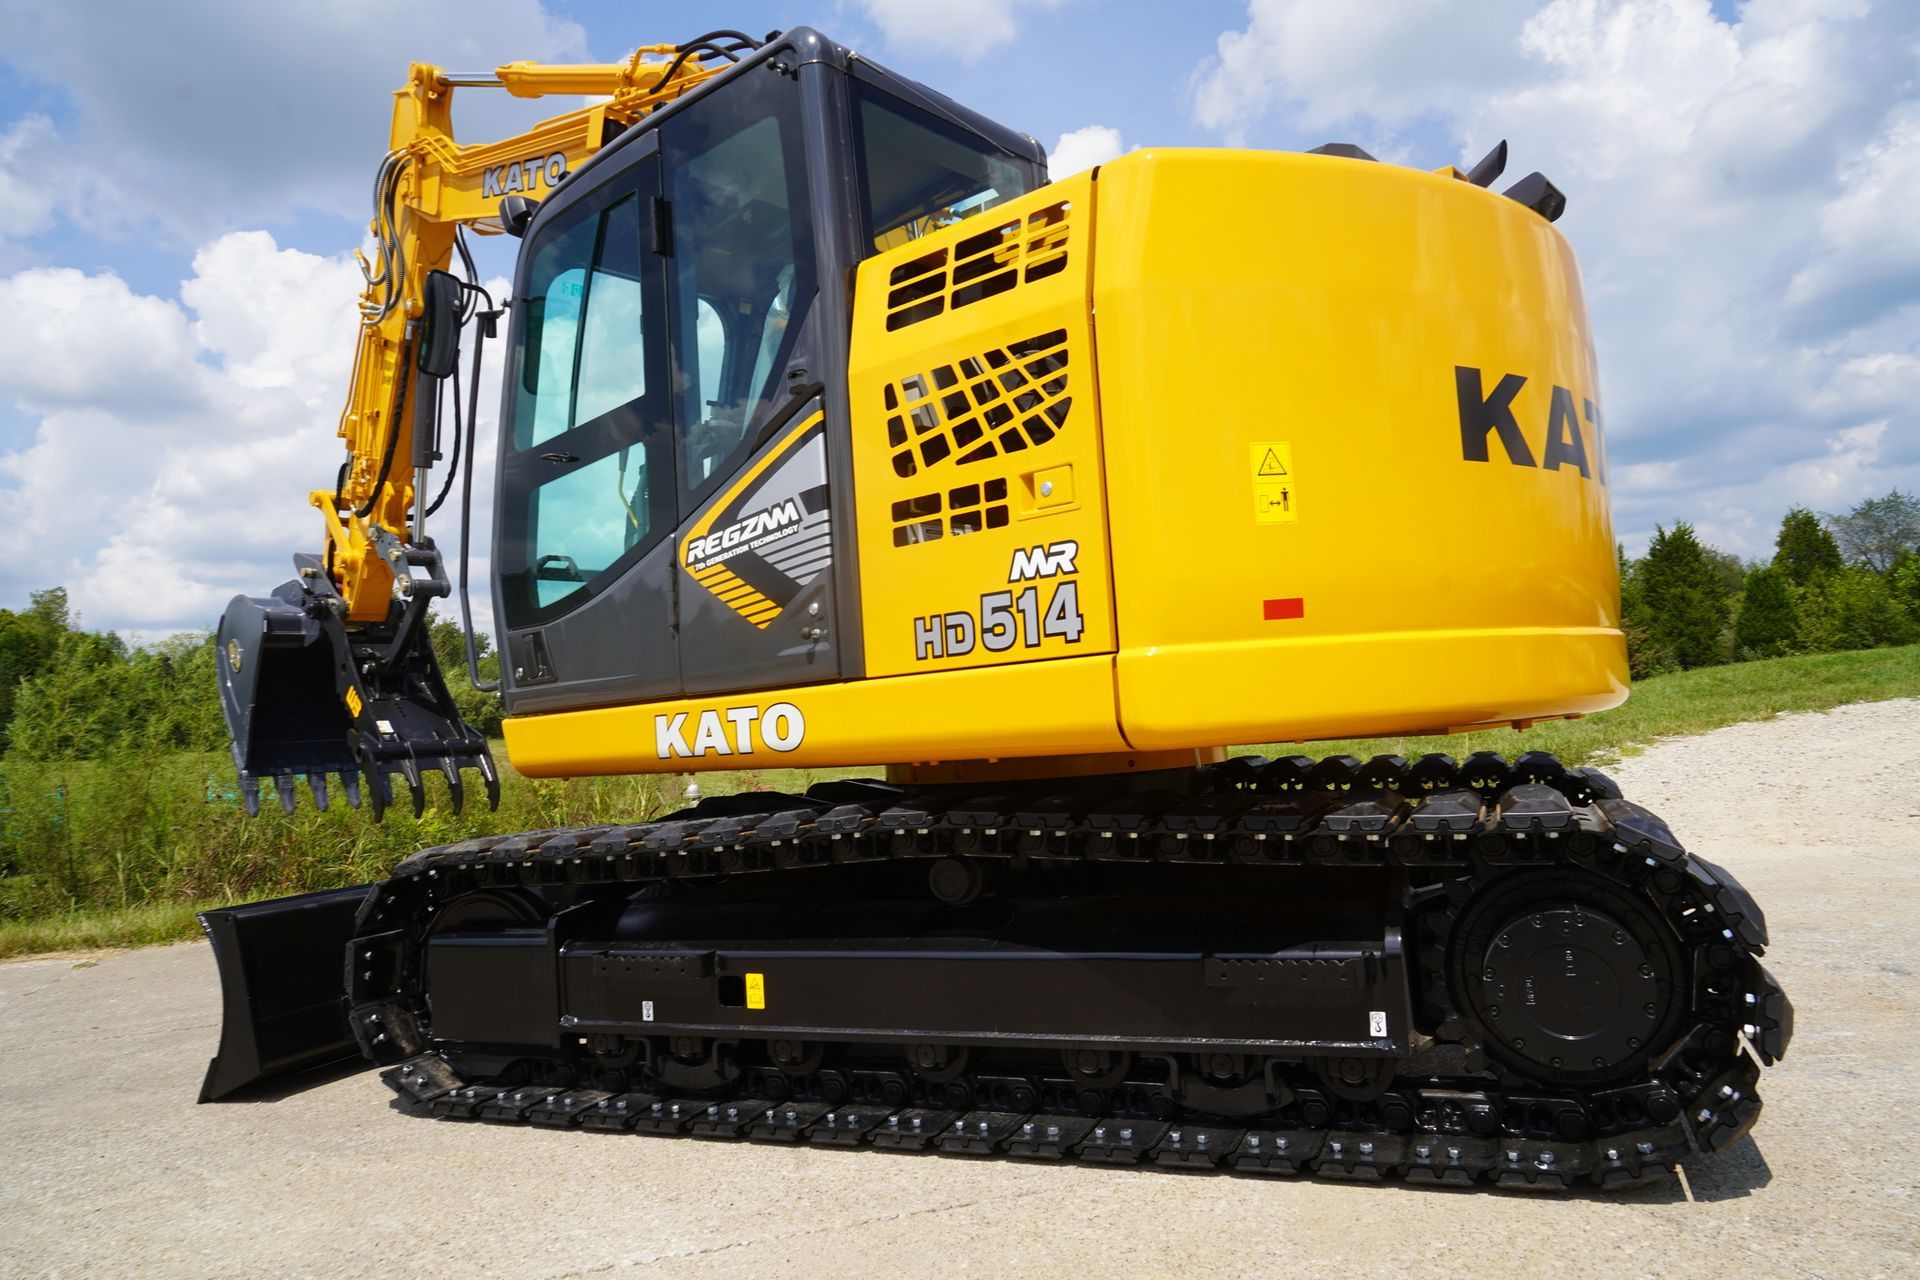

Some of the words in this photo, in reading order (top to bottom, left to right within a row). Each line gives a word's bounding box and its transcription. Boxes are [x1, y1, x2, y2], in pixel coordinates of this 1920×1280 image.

[482, 151, 567, 199] KATO
[705, 543, 750, 568] GENERATION
[749, 523, 799, 549] TECHNOLOGY
[1008, 540, 1079, 583] MR
[655, 702, 806, 759] KATO
